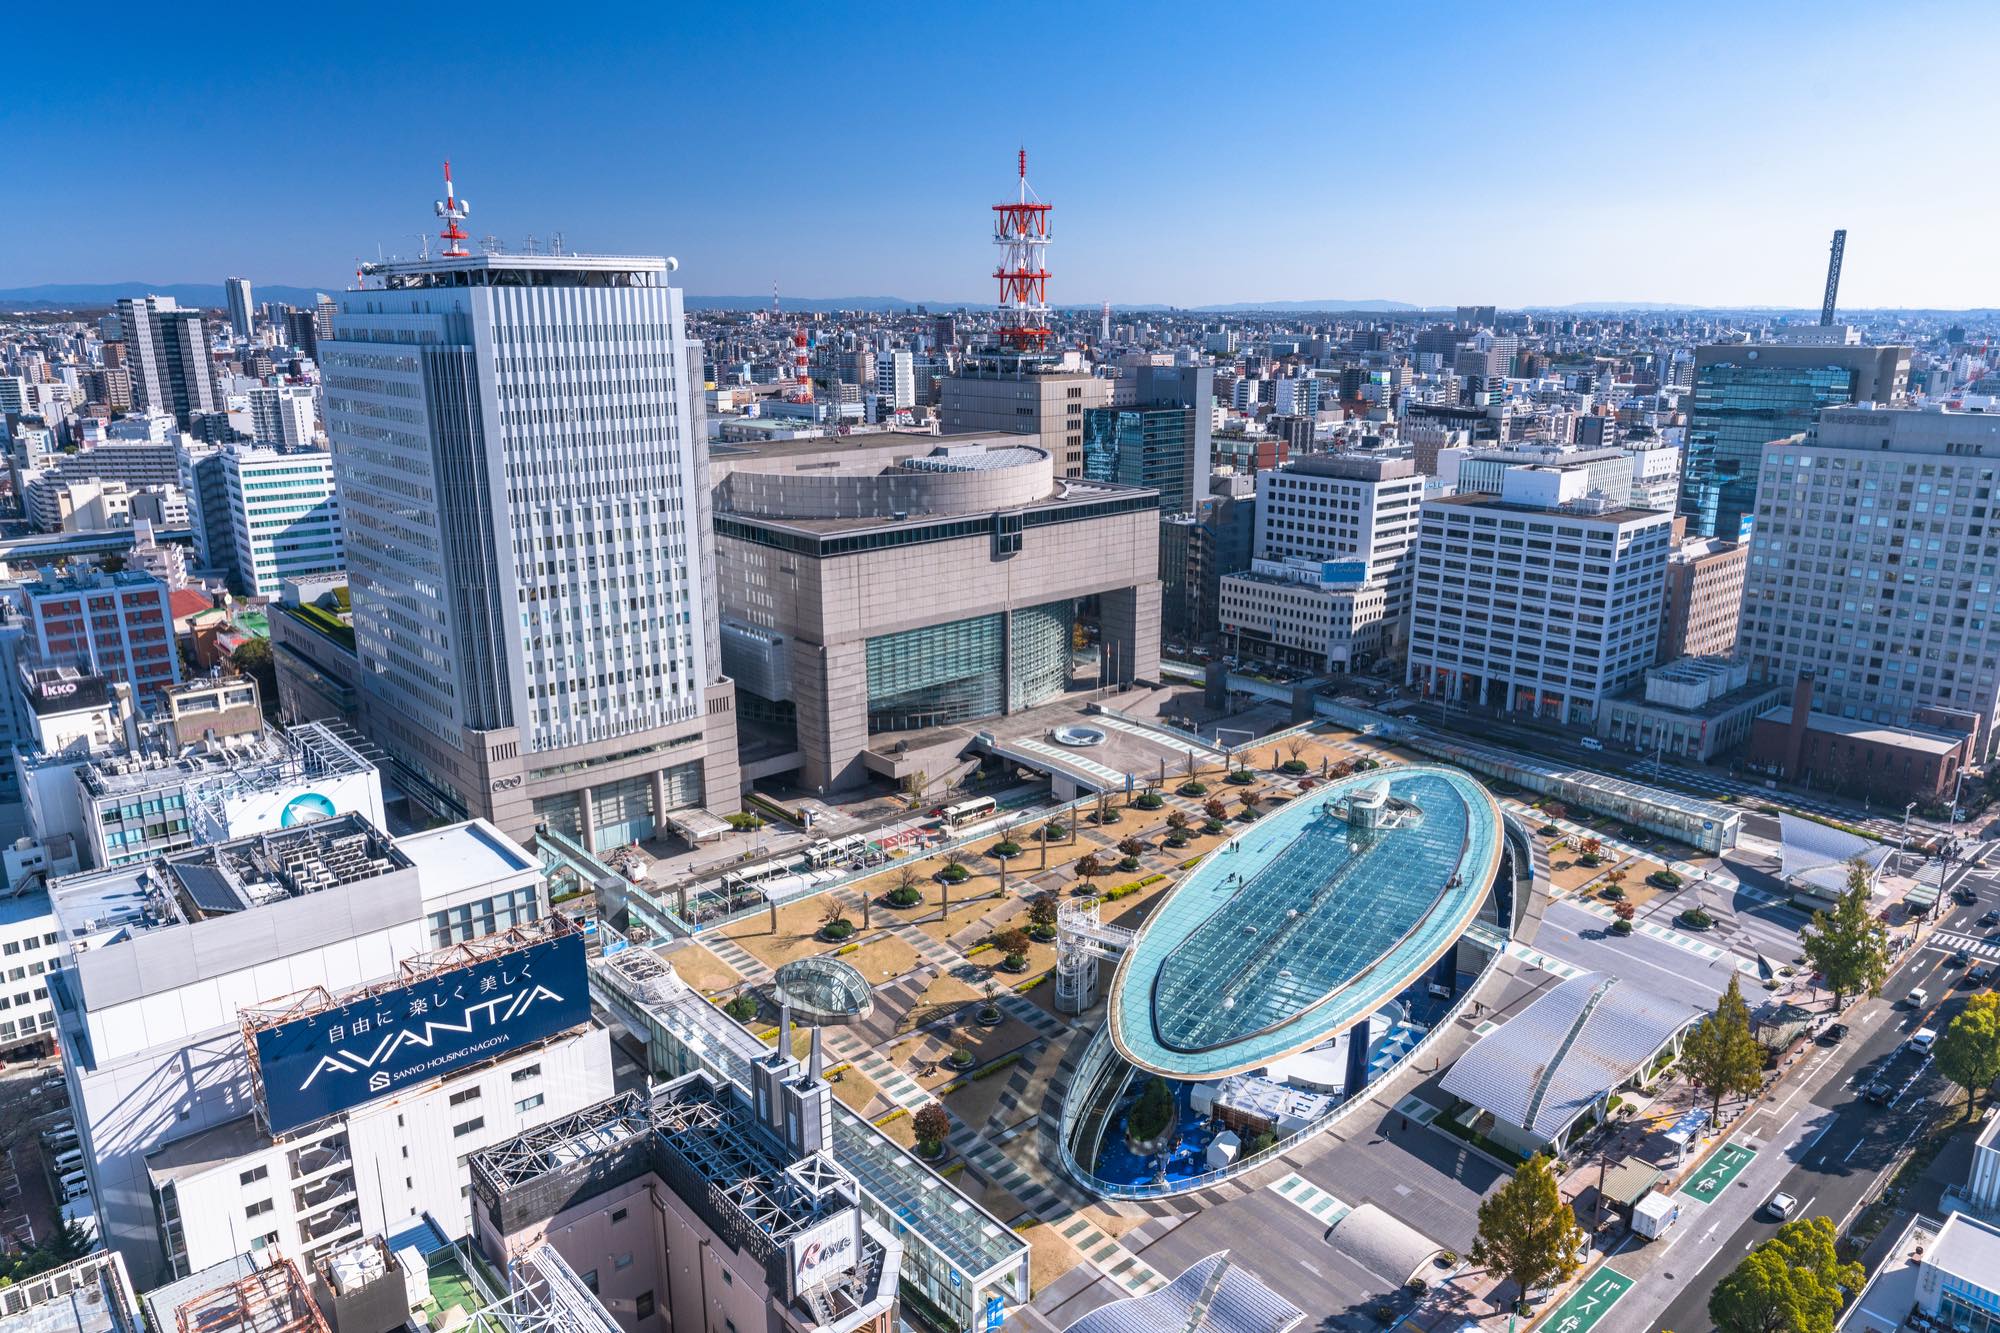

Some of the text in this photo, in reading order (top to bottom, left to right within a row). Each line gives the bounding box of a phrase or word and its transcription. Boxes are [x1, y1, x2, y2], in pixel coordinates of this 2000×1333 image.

[329, 964, 532, 1043] 自由に 楽しく 美しく
[393, 1065, 425, 1081] SANYO
[427, 1048, 469, 1069] HOUSING
[470, 1033, 510, 1054] NAGOYA
[1696, 1150, 1747, 1193] バス停
